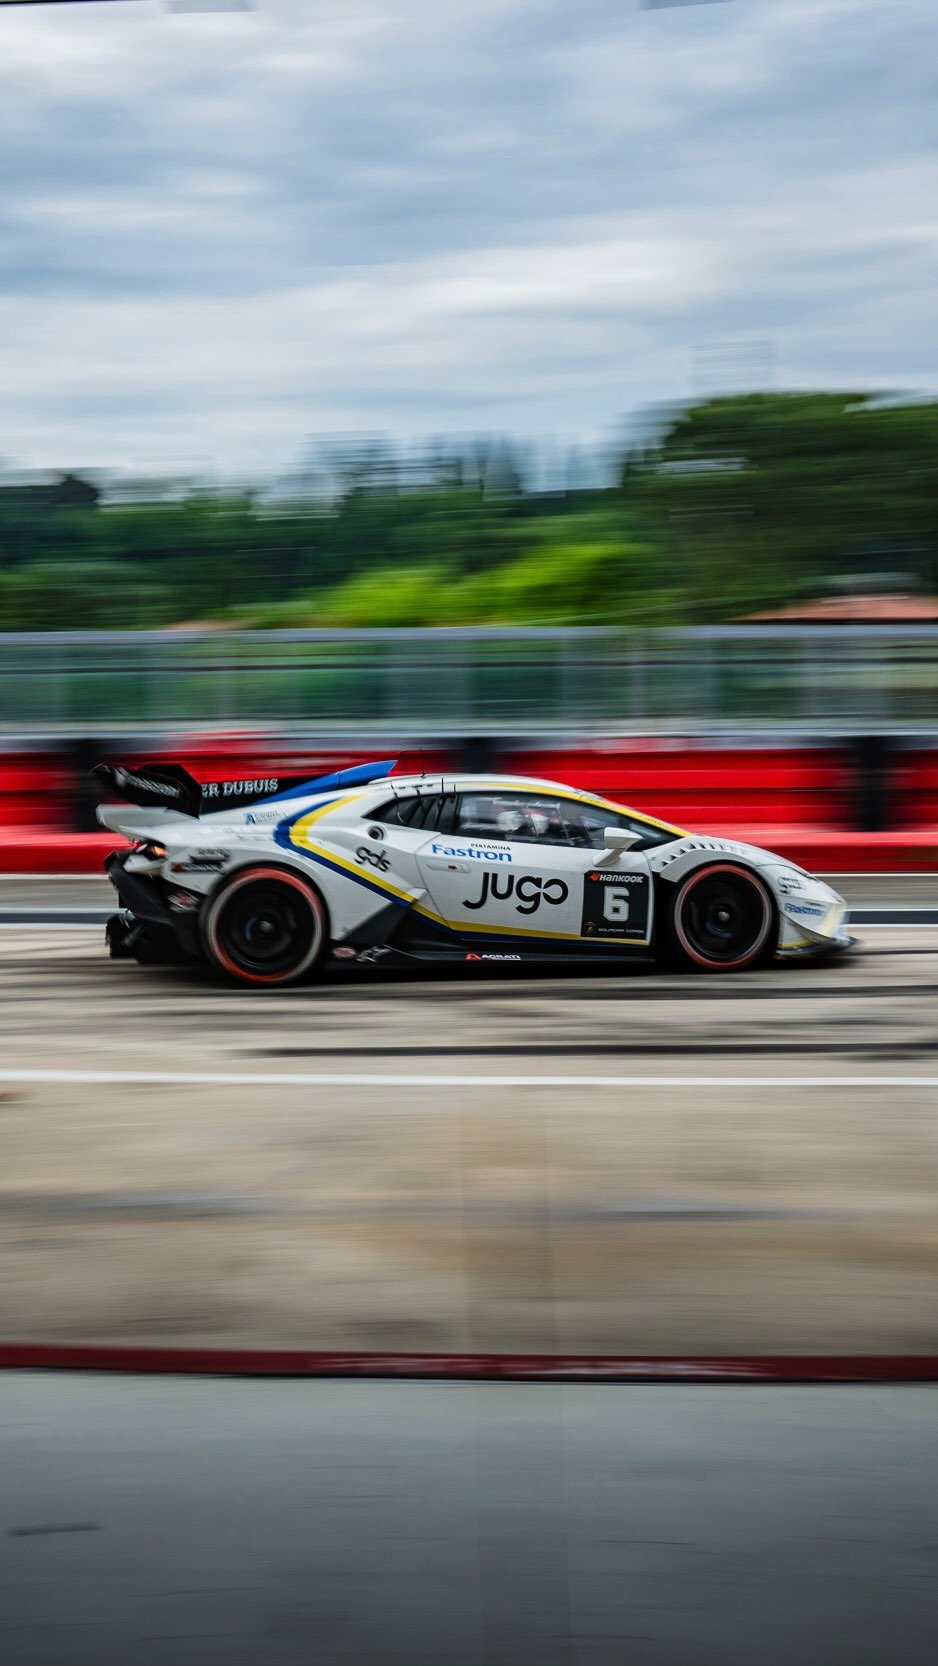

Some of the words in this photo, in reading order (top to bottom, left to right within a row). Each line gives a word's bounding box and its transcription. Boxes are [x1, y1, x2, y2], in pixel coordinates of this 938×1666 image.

[223, 778, 278, 796] DUBUIS
[432, 843, 512, 862] Fastron
[603, 886, 630, 921] 6
